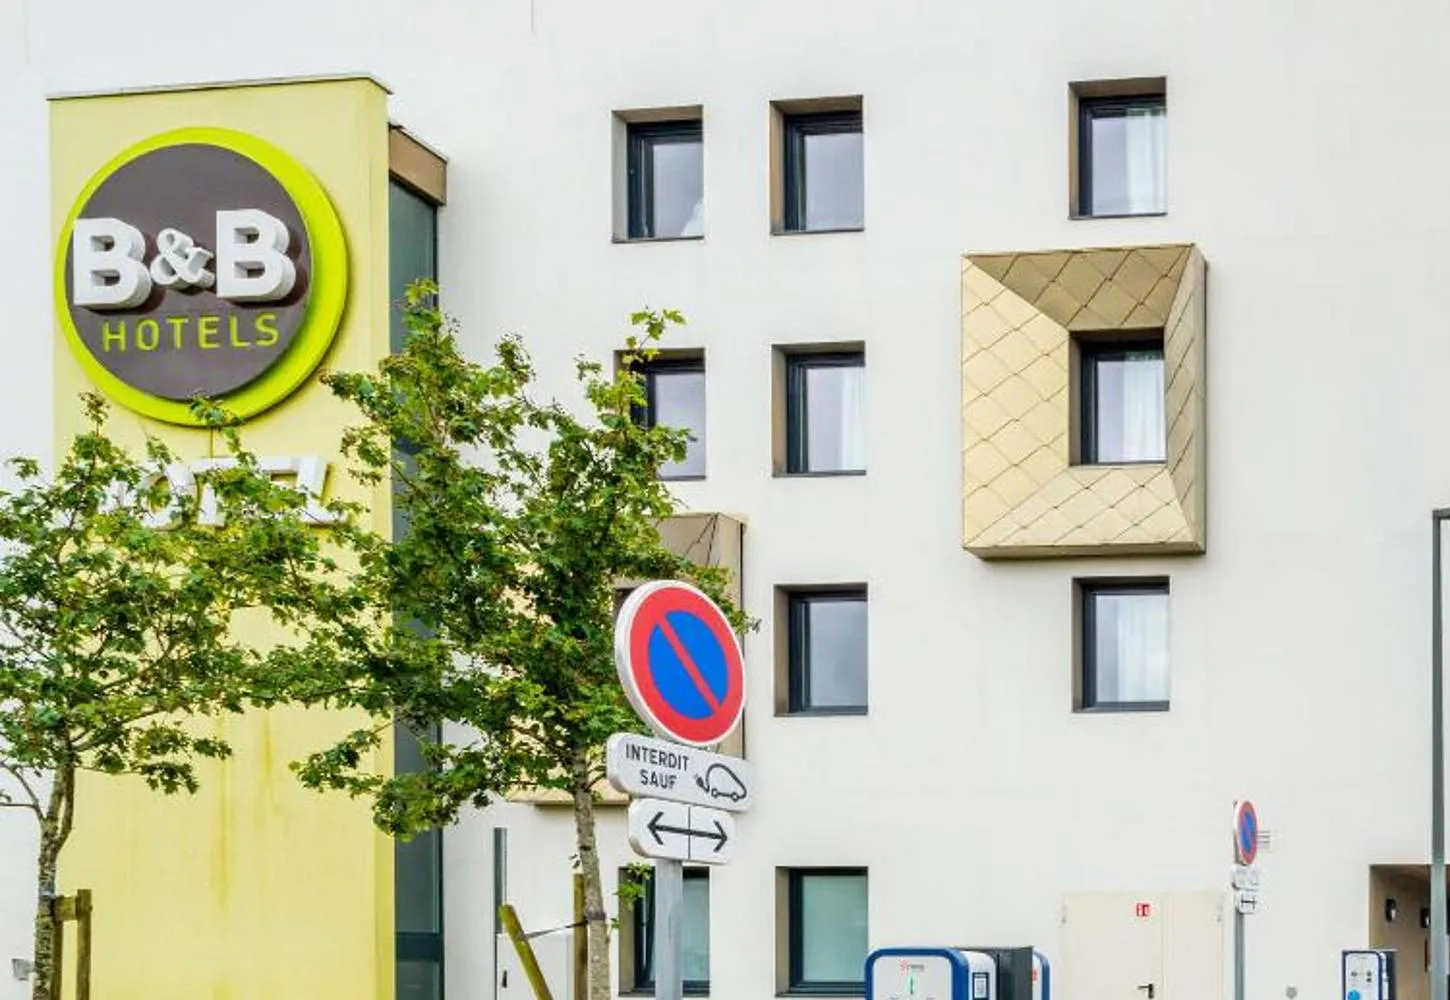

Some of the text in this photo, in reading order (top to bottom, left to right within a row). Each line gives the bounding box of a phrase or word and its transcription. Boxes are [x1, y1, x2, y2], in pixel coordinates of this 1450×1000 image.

[72, 208, 297, 309] B&B
[101, 312, 281, 353] HOTELS
[625, 743, 689, 772] INTERDIT
[640, 768, 677, 789] SAUF
